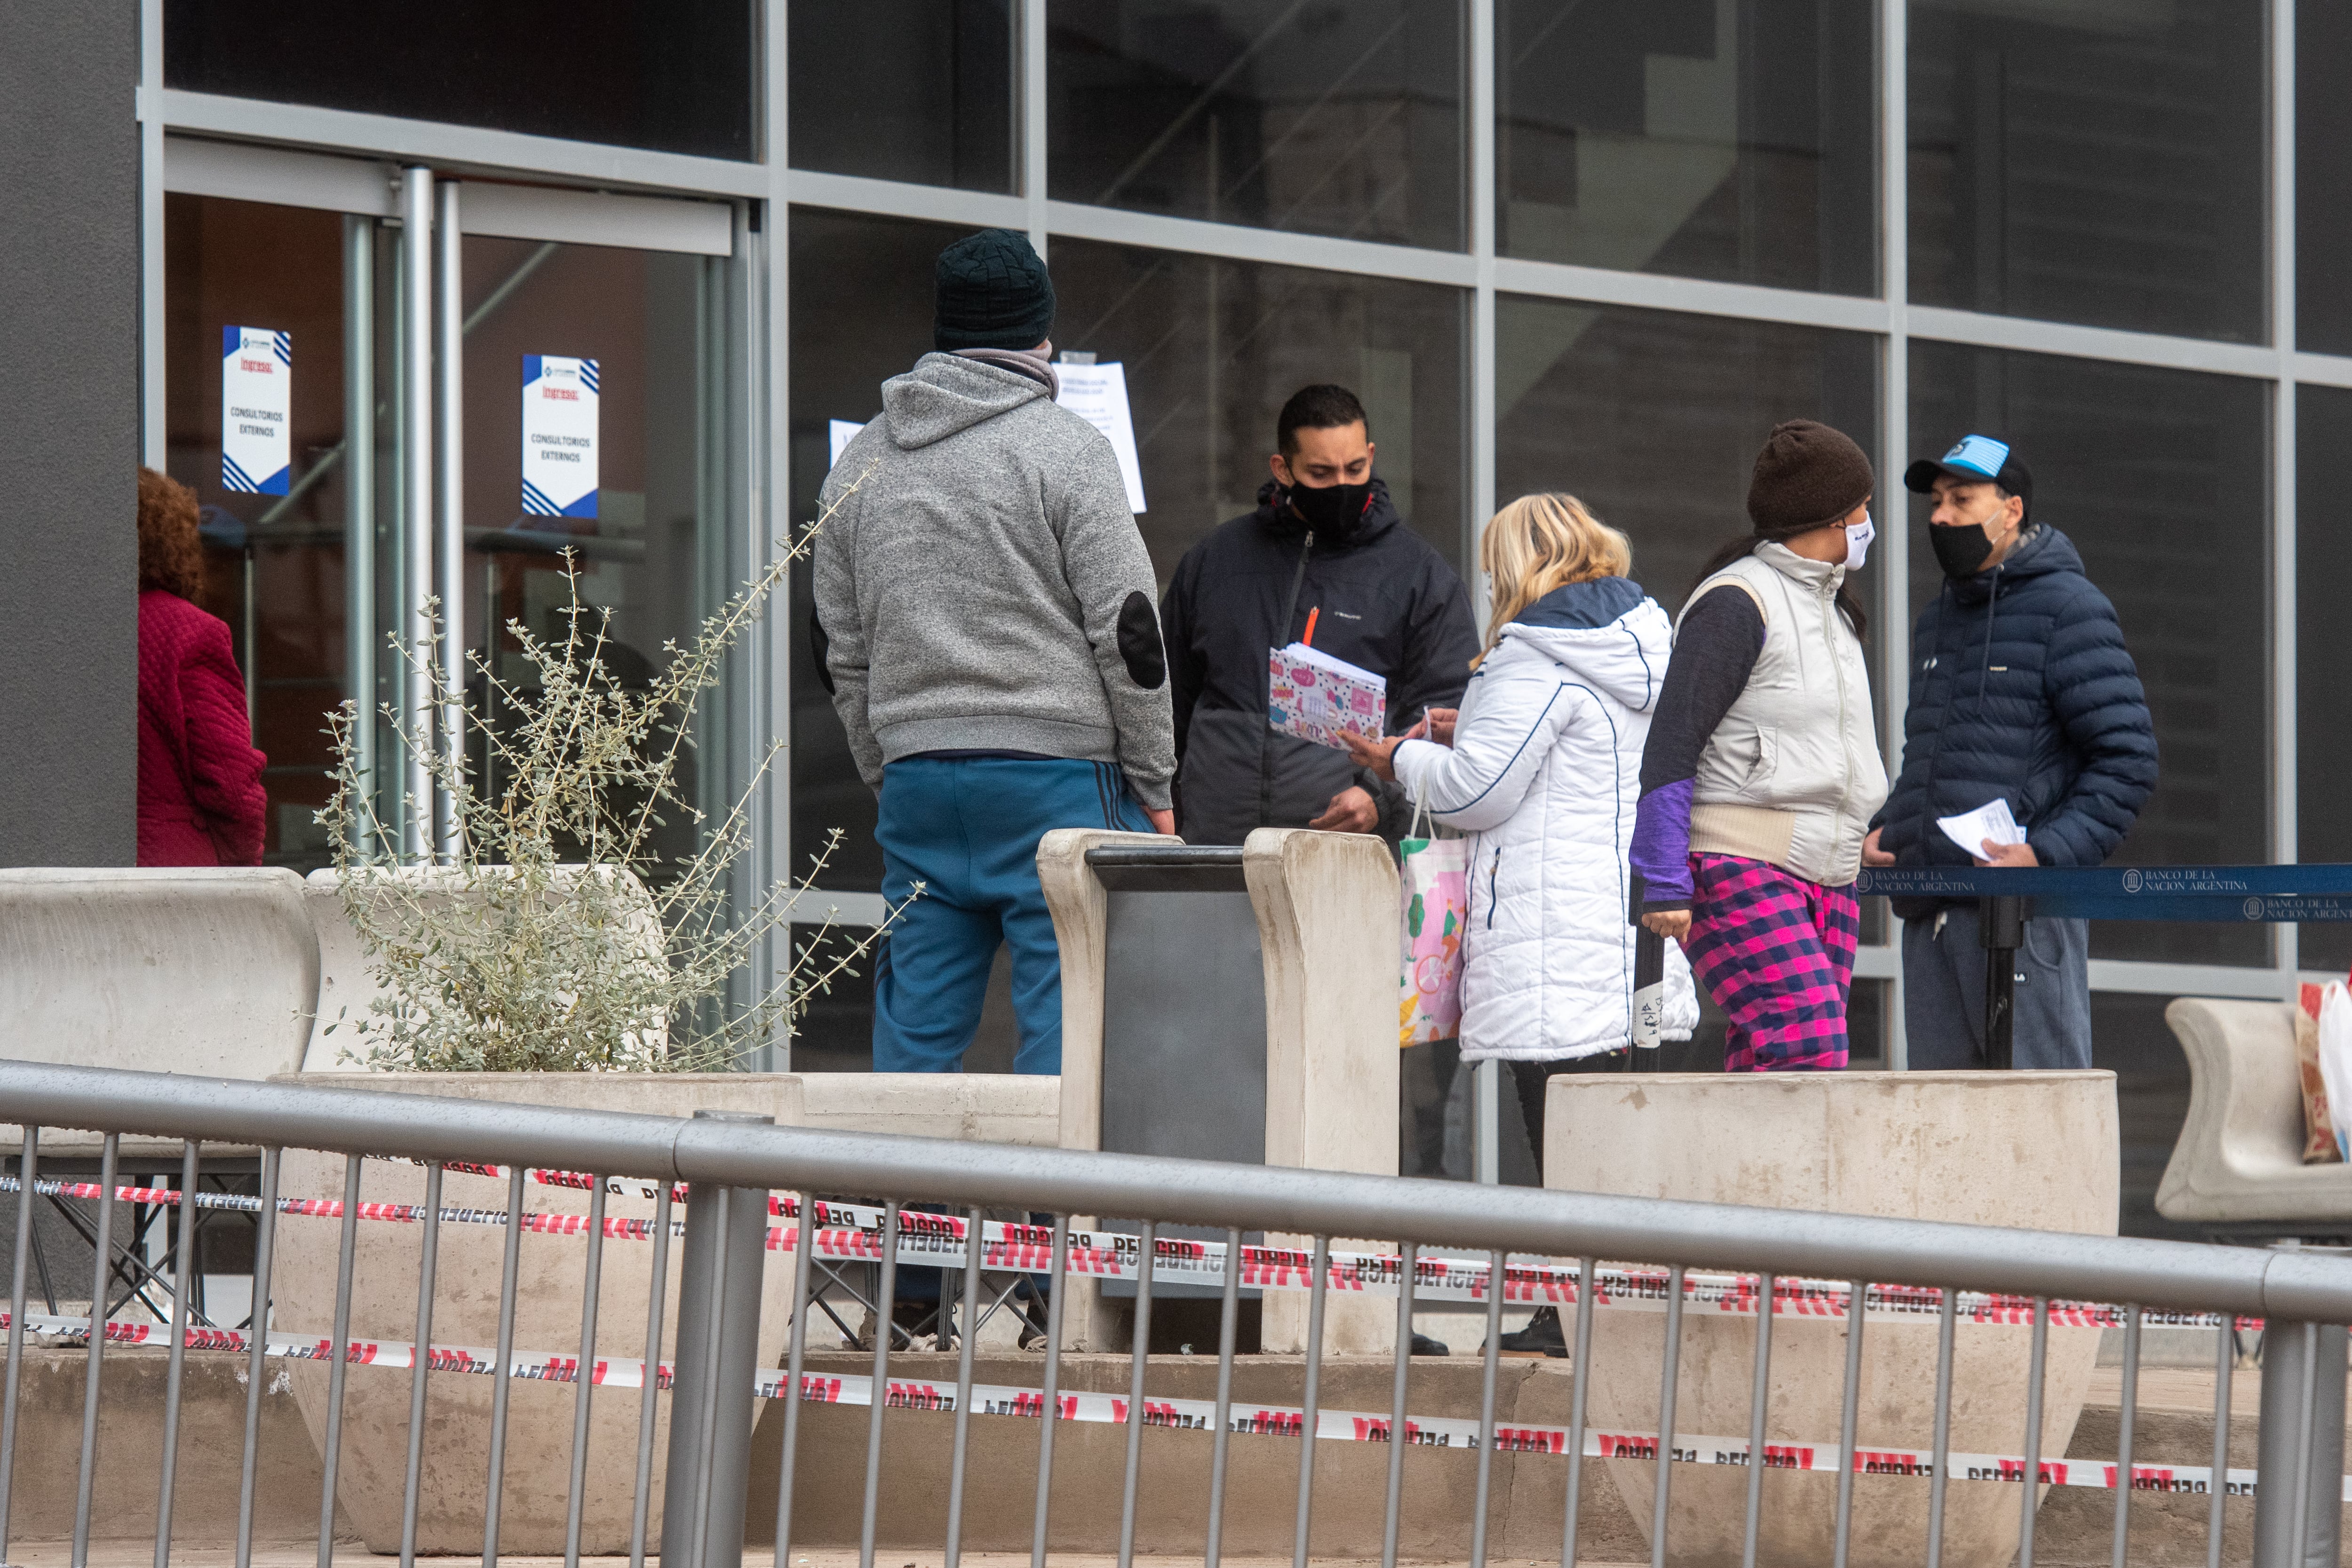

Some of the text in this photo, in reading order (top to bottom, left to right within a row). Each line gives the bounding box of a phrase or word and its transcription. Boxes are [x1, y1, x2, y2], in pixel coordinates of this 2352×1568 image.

[230, 407, 283, 422] CONSULTORIOS
[239, 424, 274, 438] EXTERNOS
[531, 433, 590, 447] CONSULTORIOS
[541, 450, 580, 463] EXTERNOS
[1875, 871, 1943, 880] BANCO DE LA
[2145, 871, 2215, 880] BANCO DE LA
[1875, 882, 1975, 891] NACION ARGENTINA
[2145, 881, 2247, 891] NACION ARGENTINA
[2267, 899, 2338, 908] BANCO DE LA
[2267, 909, 2307, 918] NACION
